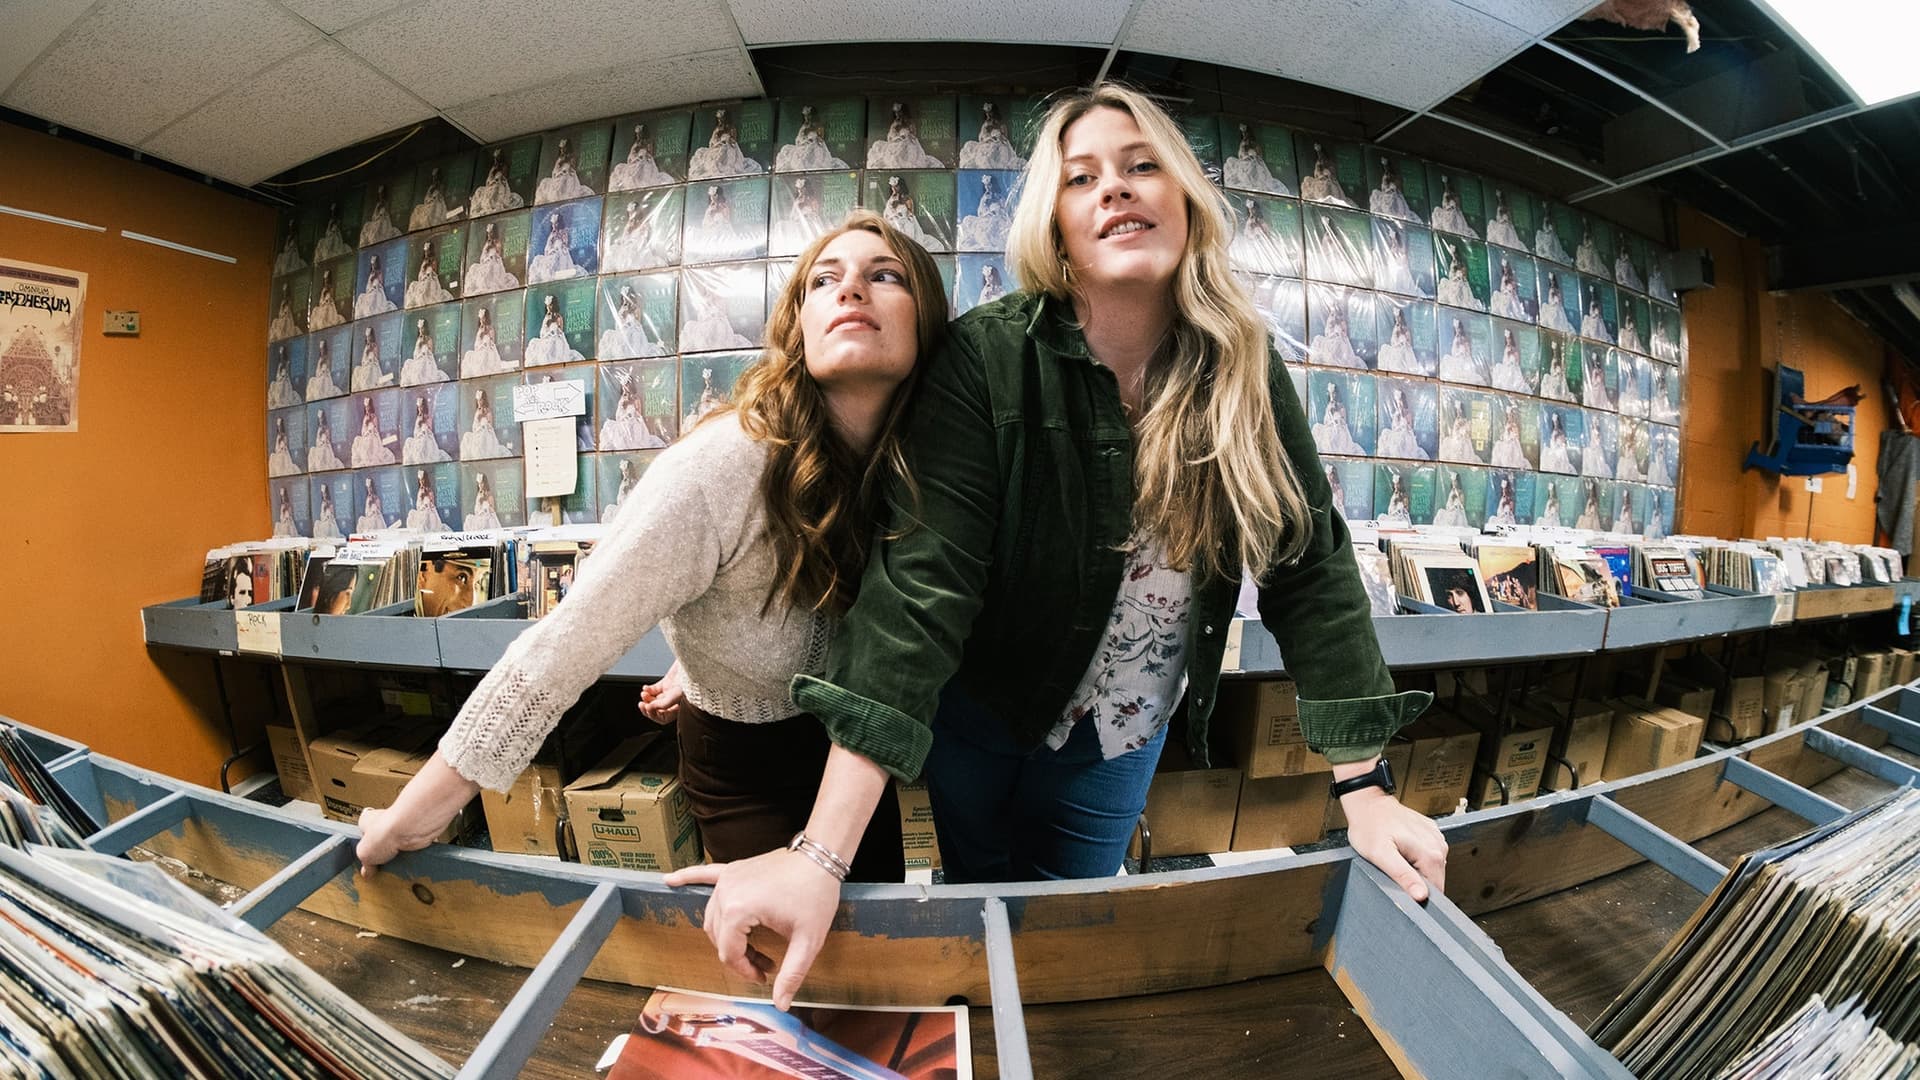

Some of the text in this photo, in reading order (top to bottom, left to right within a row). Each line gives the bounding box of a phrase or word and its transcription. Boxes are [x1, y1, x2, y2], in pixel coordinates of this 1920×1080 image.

[18, 284, 50, 295] OMNIUM
[247, 613, 267, 628] ROCK
[595, 826, 637, 836] U-HAUL
[591, 849, 613, 859] 100%
